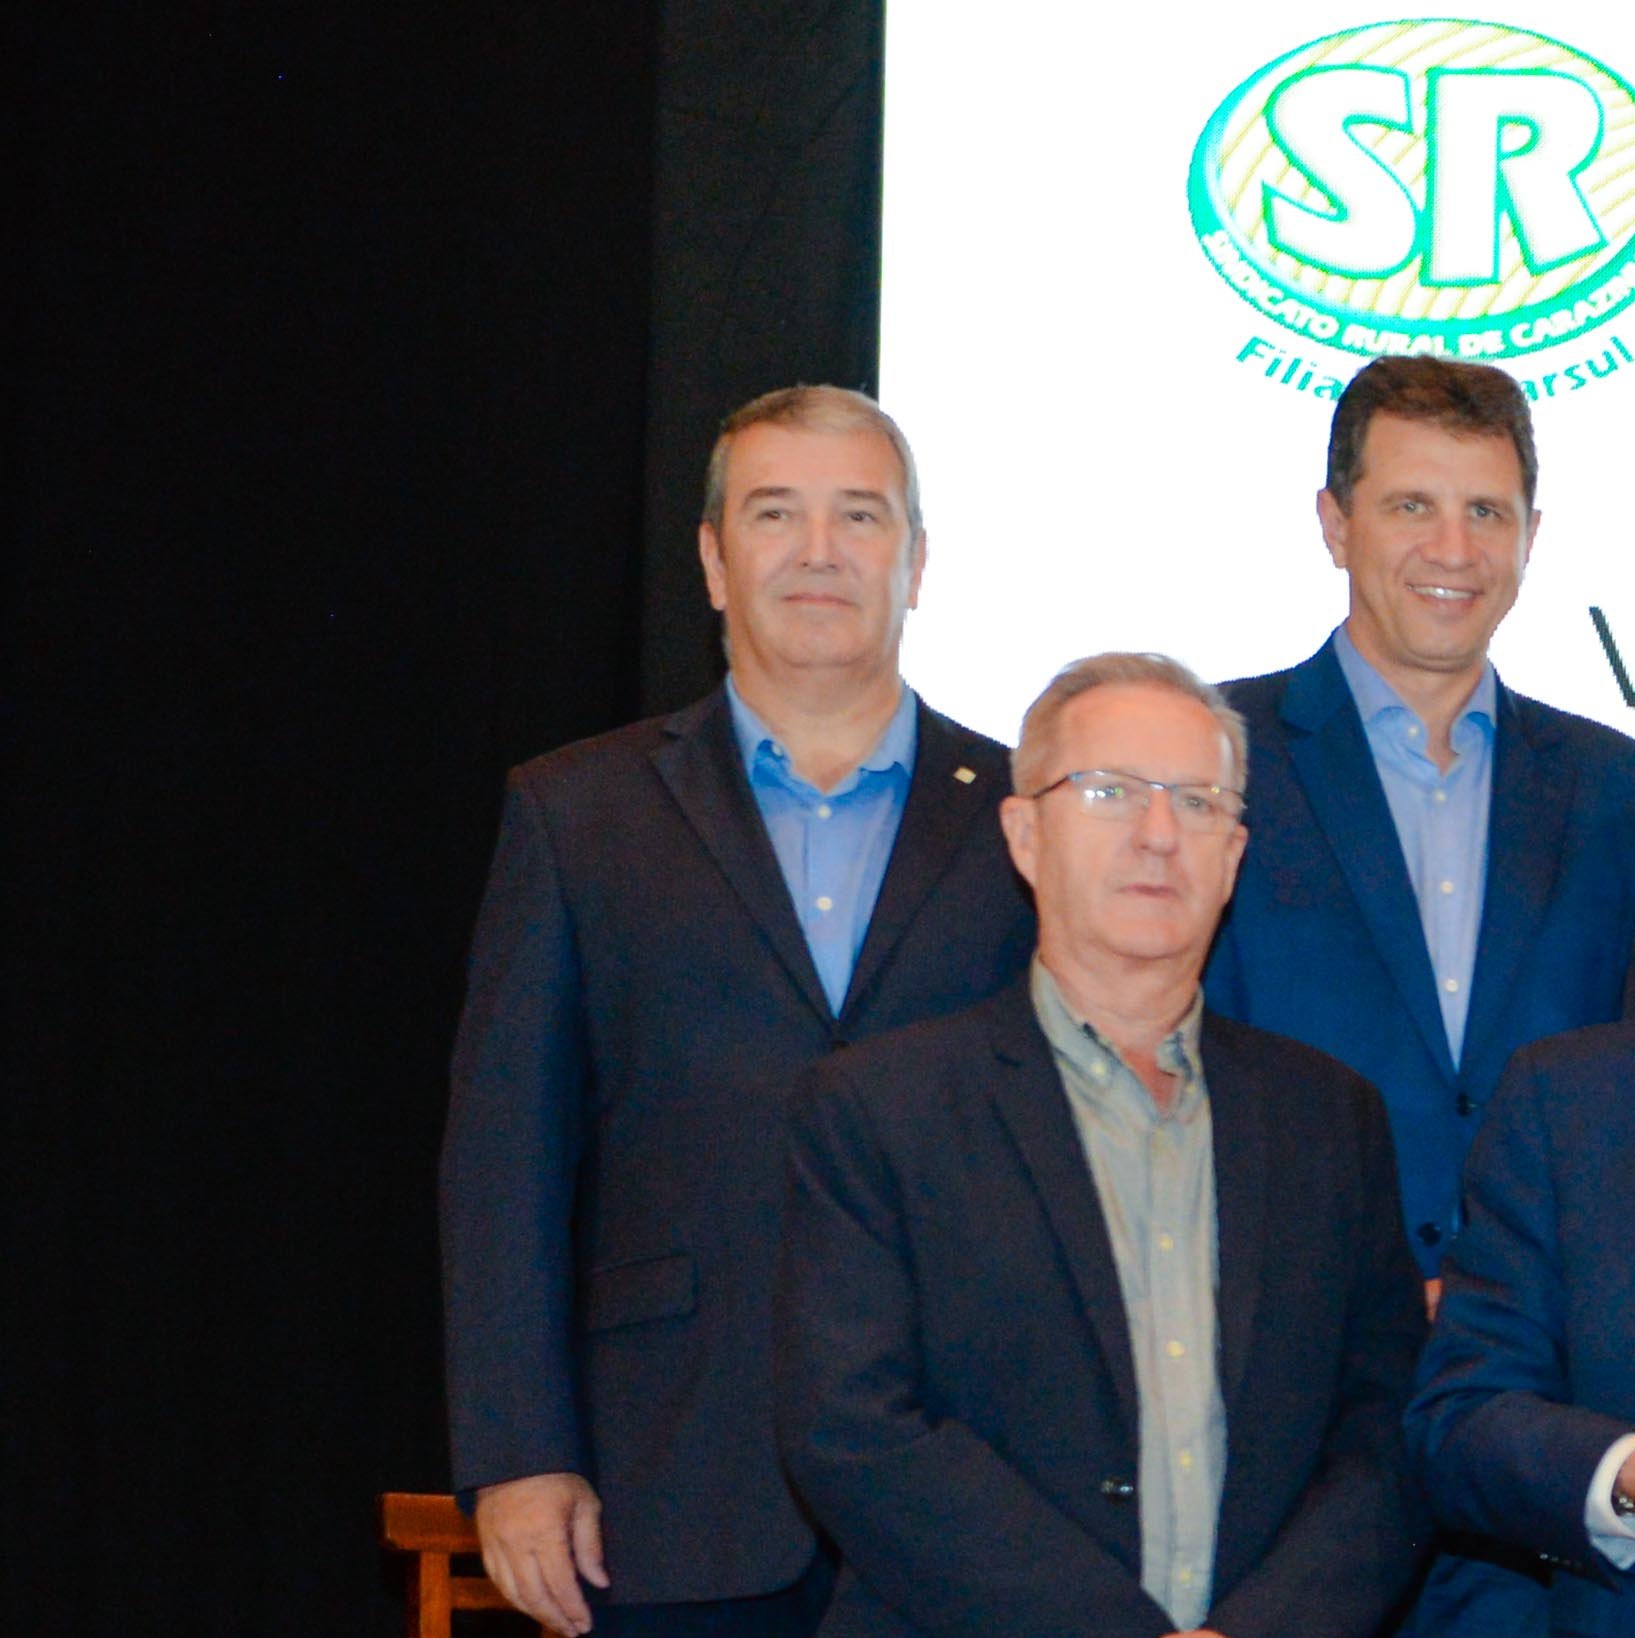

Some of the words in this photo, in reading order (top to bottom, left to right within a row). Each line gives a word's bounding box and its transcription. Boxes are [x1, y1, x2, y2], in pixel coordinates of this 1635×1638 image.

[1261, 62, 1609, 287] SR
[1235, 335, 1345, 402] Filia
[1520, 335, 1635, 402] arsul
[1457, 329, 1505, 357] DE
